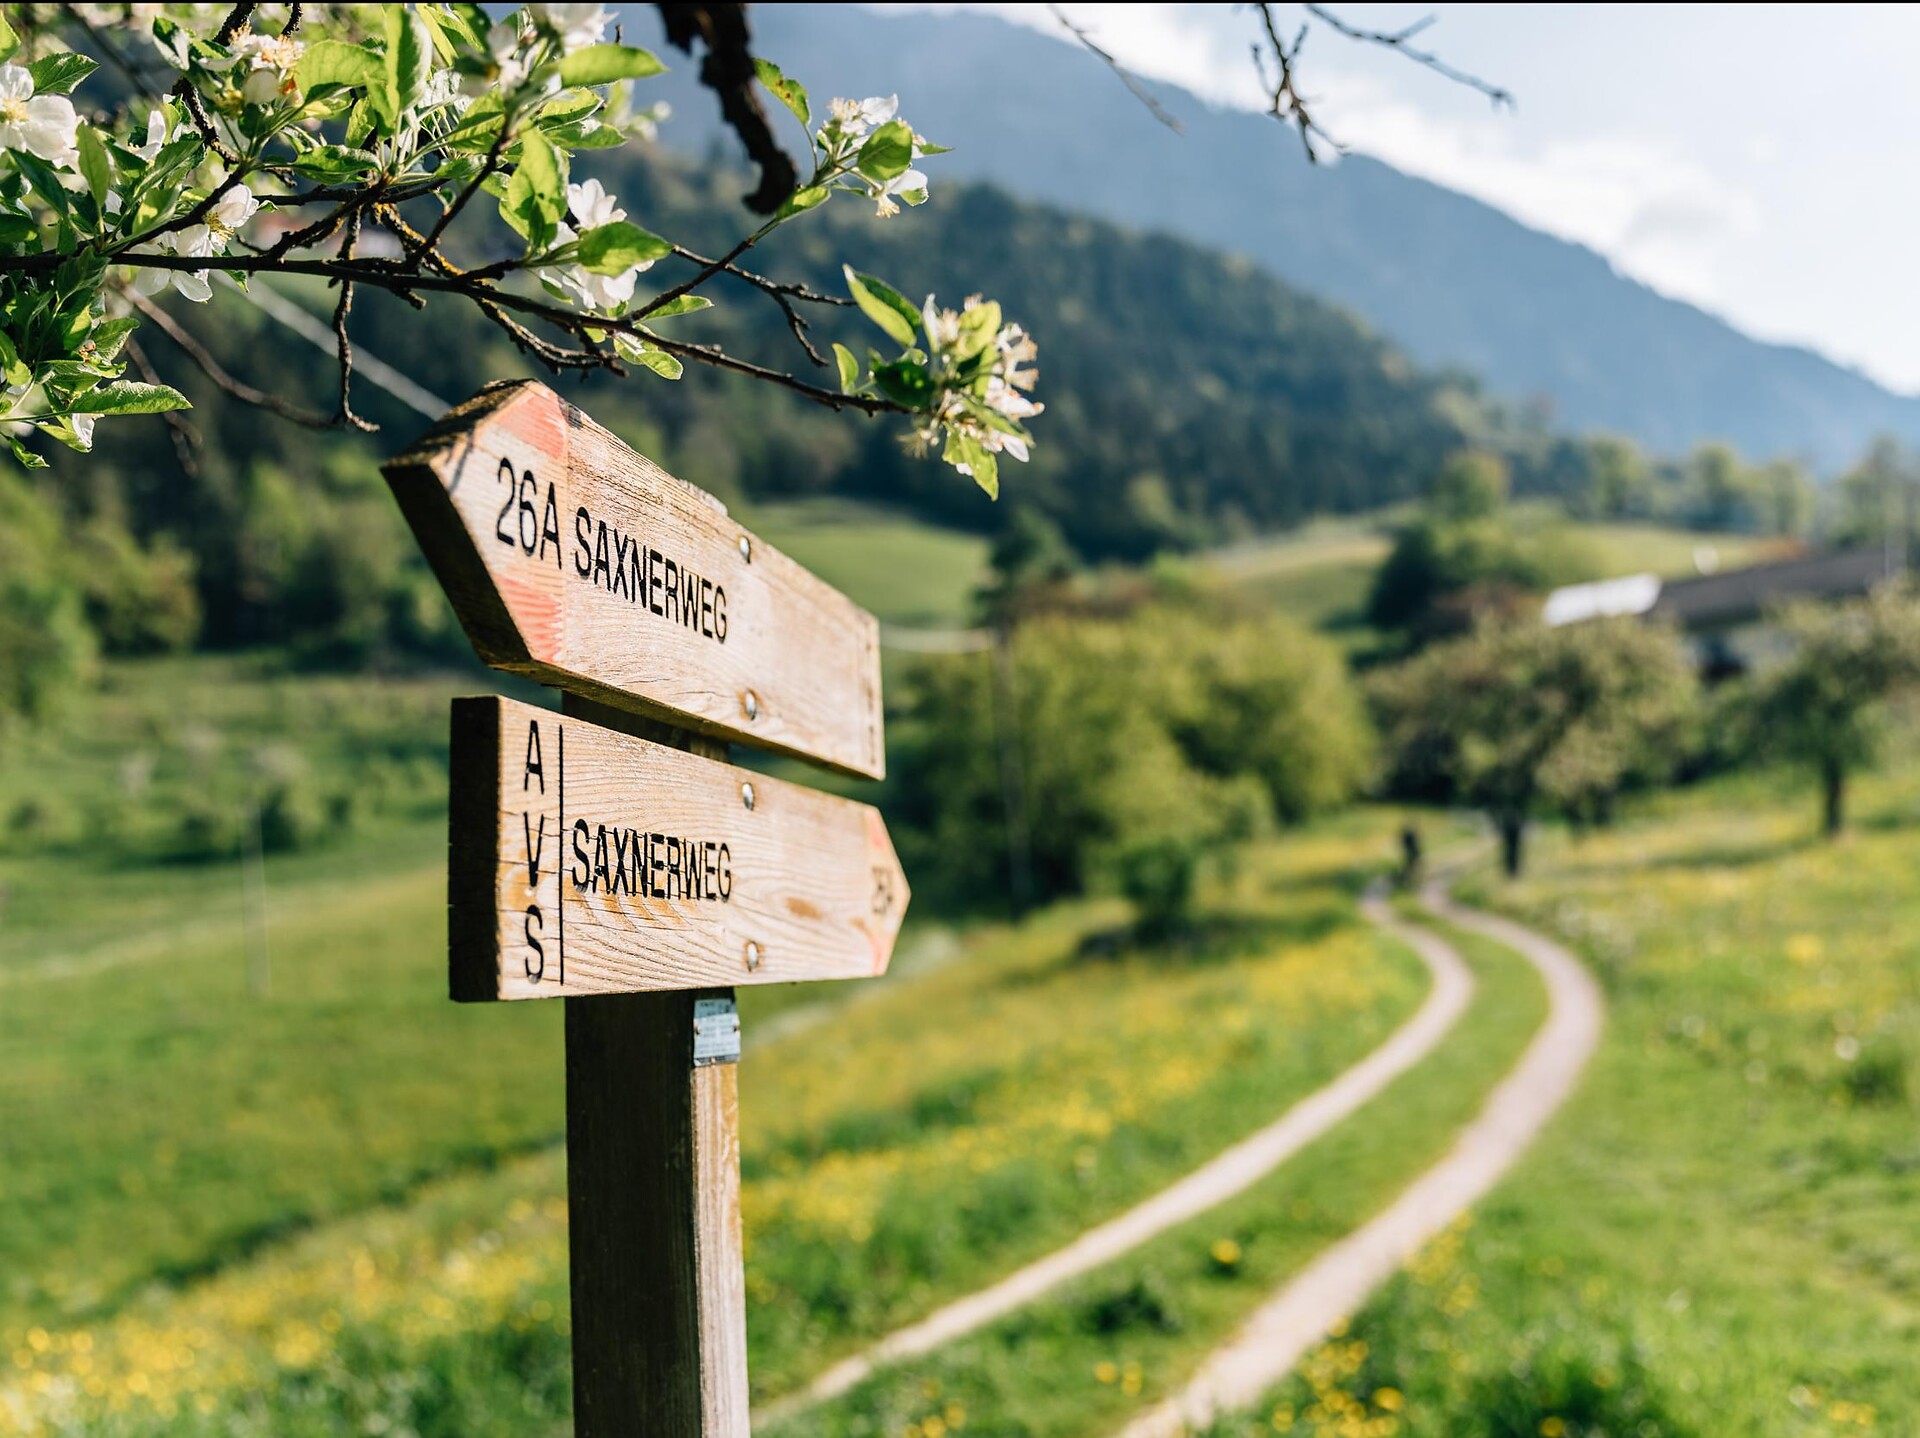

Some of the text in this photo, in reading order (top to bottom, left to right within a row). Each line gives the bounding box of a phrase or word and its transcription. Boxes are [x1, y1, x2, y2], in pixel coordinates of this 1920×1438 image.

[496, 457, 727, 643] 26A SAXNERWEG
[572, 818, 732, 904] SAXNERWEG
